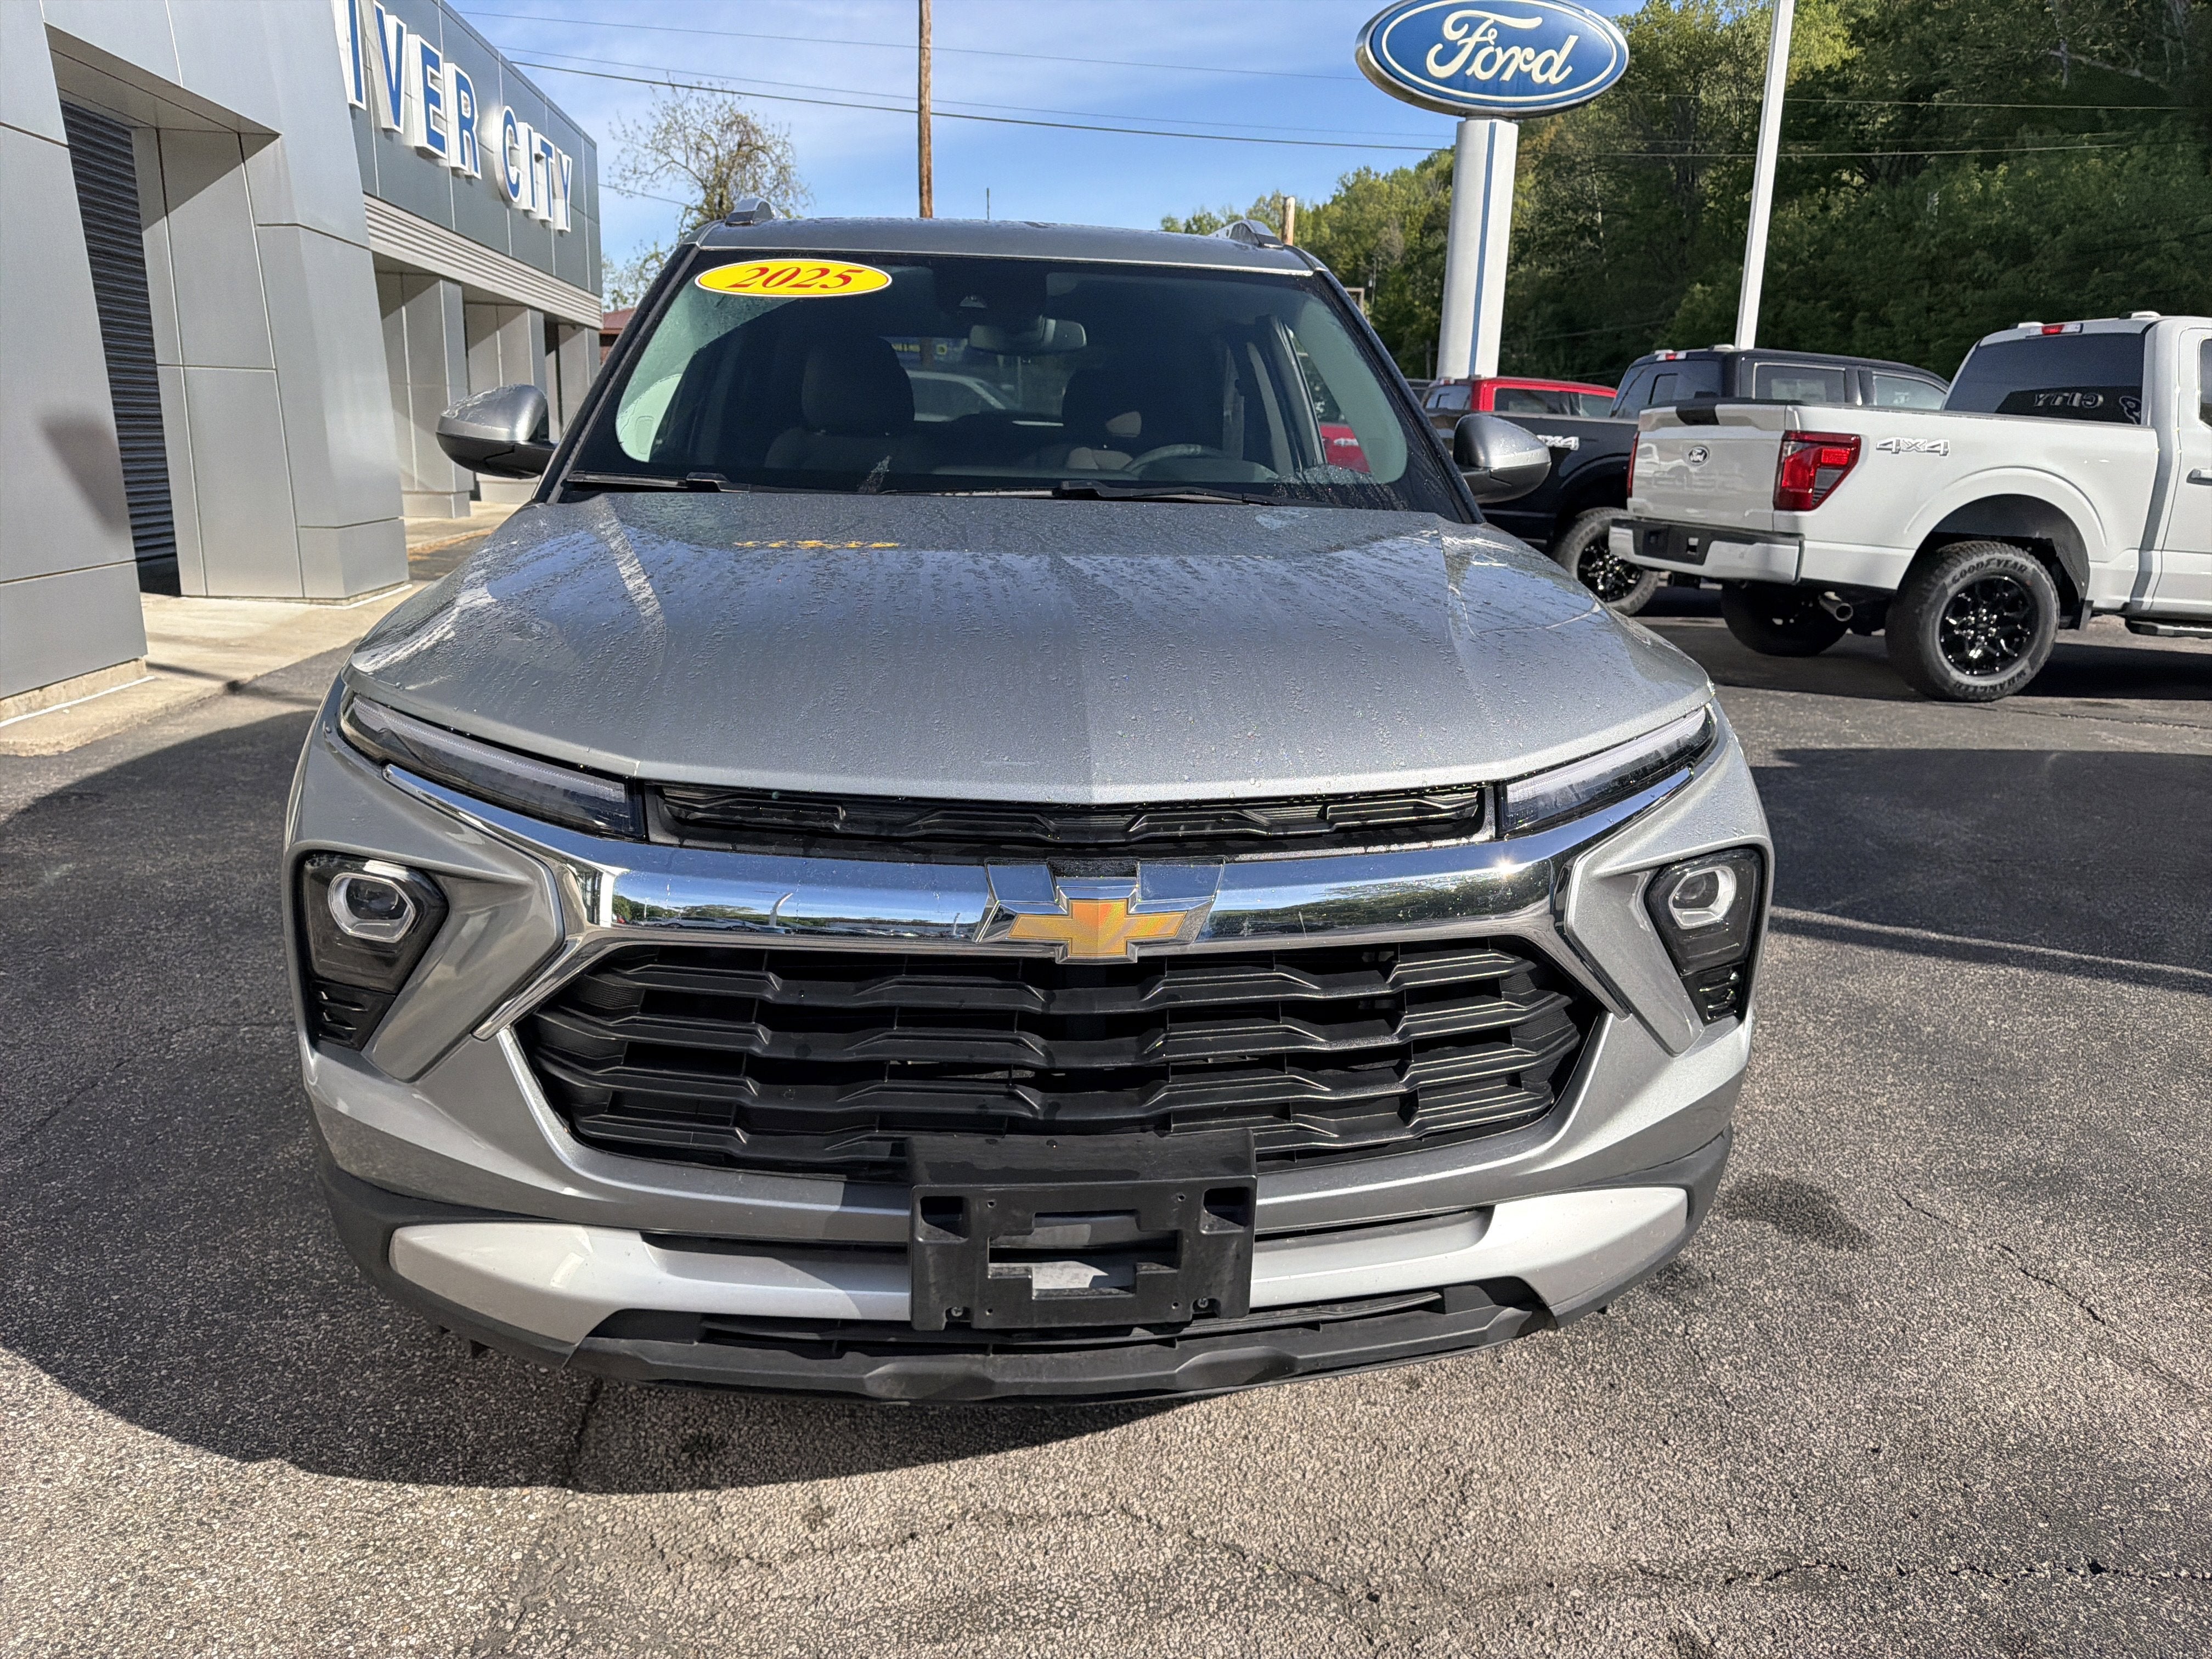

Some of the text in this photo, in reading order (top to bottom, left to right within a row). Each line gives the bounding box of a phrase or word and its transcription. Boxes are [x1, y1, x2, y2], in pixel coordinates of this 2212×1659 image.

[1426, 9, 1579, 84] Ford
[496, 105, 572, 233] CITY
[725, 267, 865, 289] 2025
[1951, 557, 2028, 584] GOODYEAR
